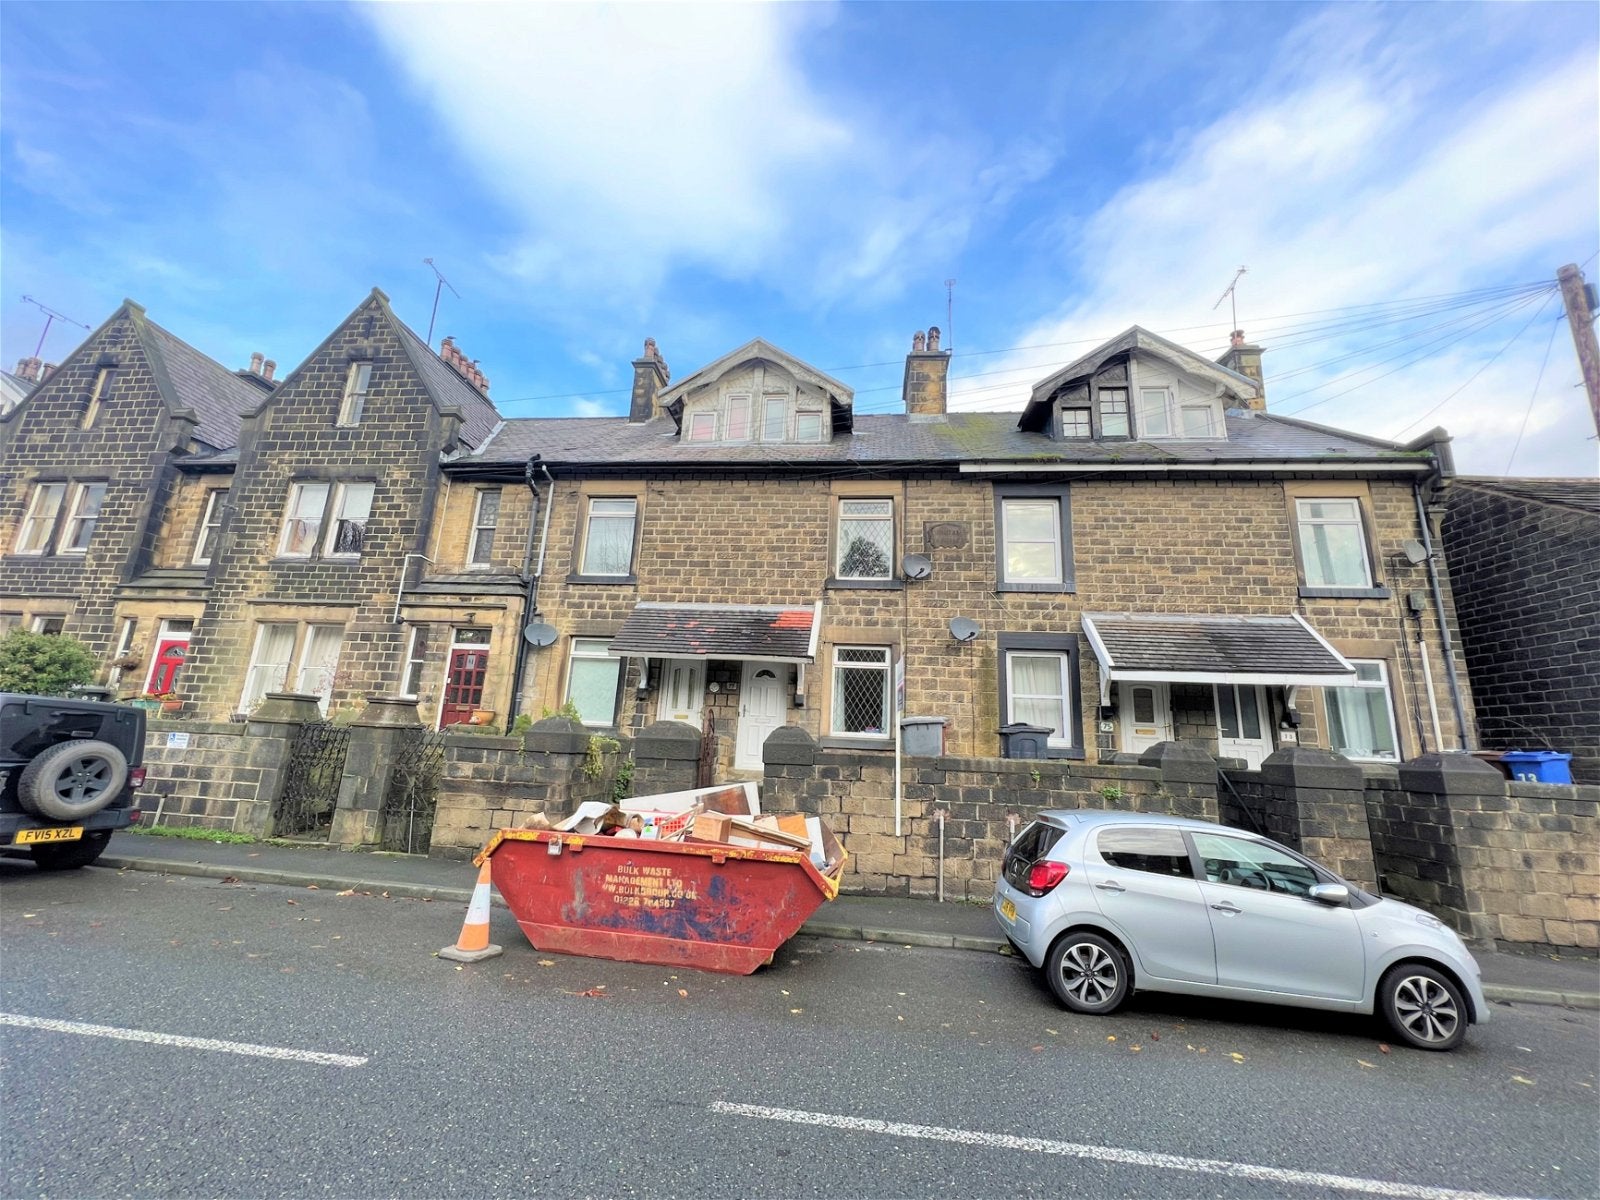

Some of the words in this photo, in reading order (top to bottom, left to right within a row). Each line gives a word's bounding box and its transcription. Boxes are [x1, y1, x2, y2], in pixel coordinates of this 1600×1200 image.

[25, 830, 52, 841] FV15
[53, 828, 75, 840] XZL
[617, 865, 640, 876] BULK
[642, 866, 673, 876] WASTE
[605, 874, 664, 888] MANAGEMENT
[666, 878, 683, 889] LTD
